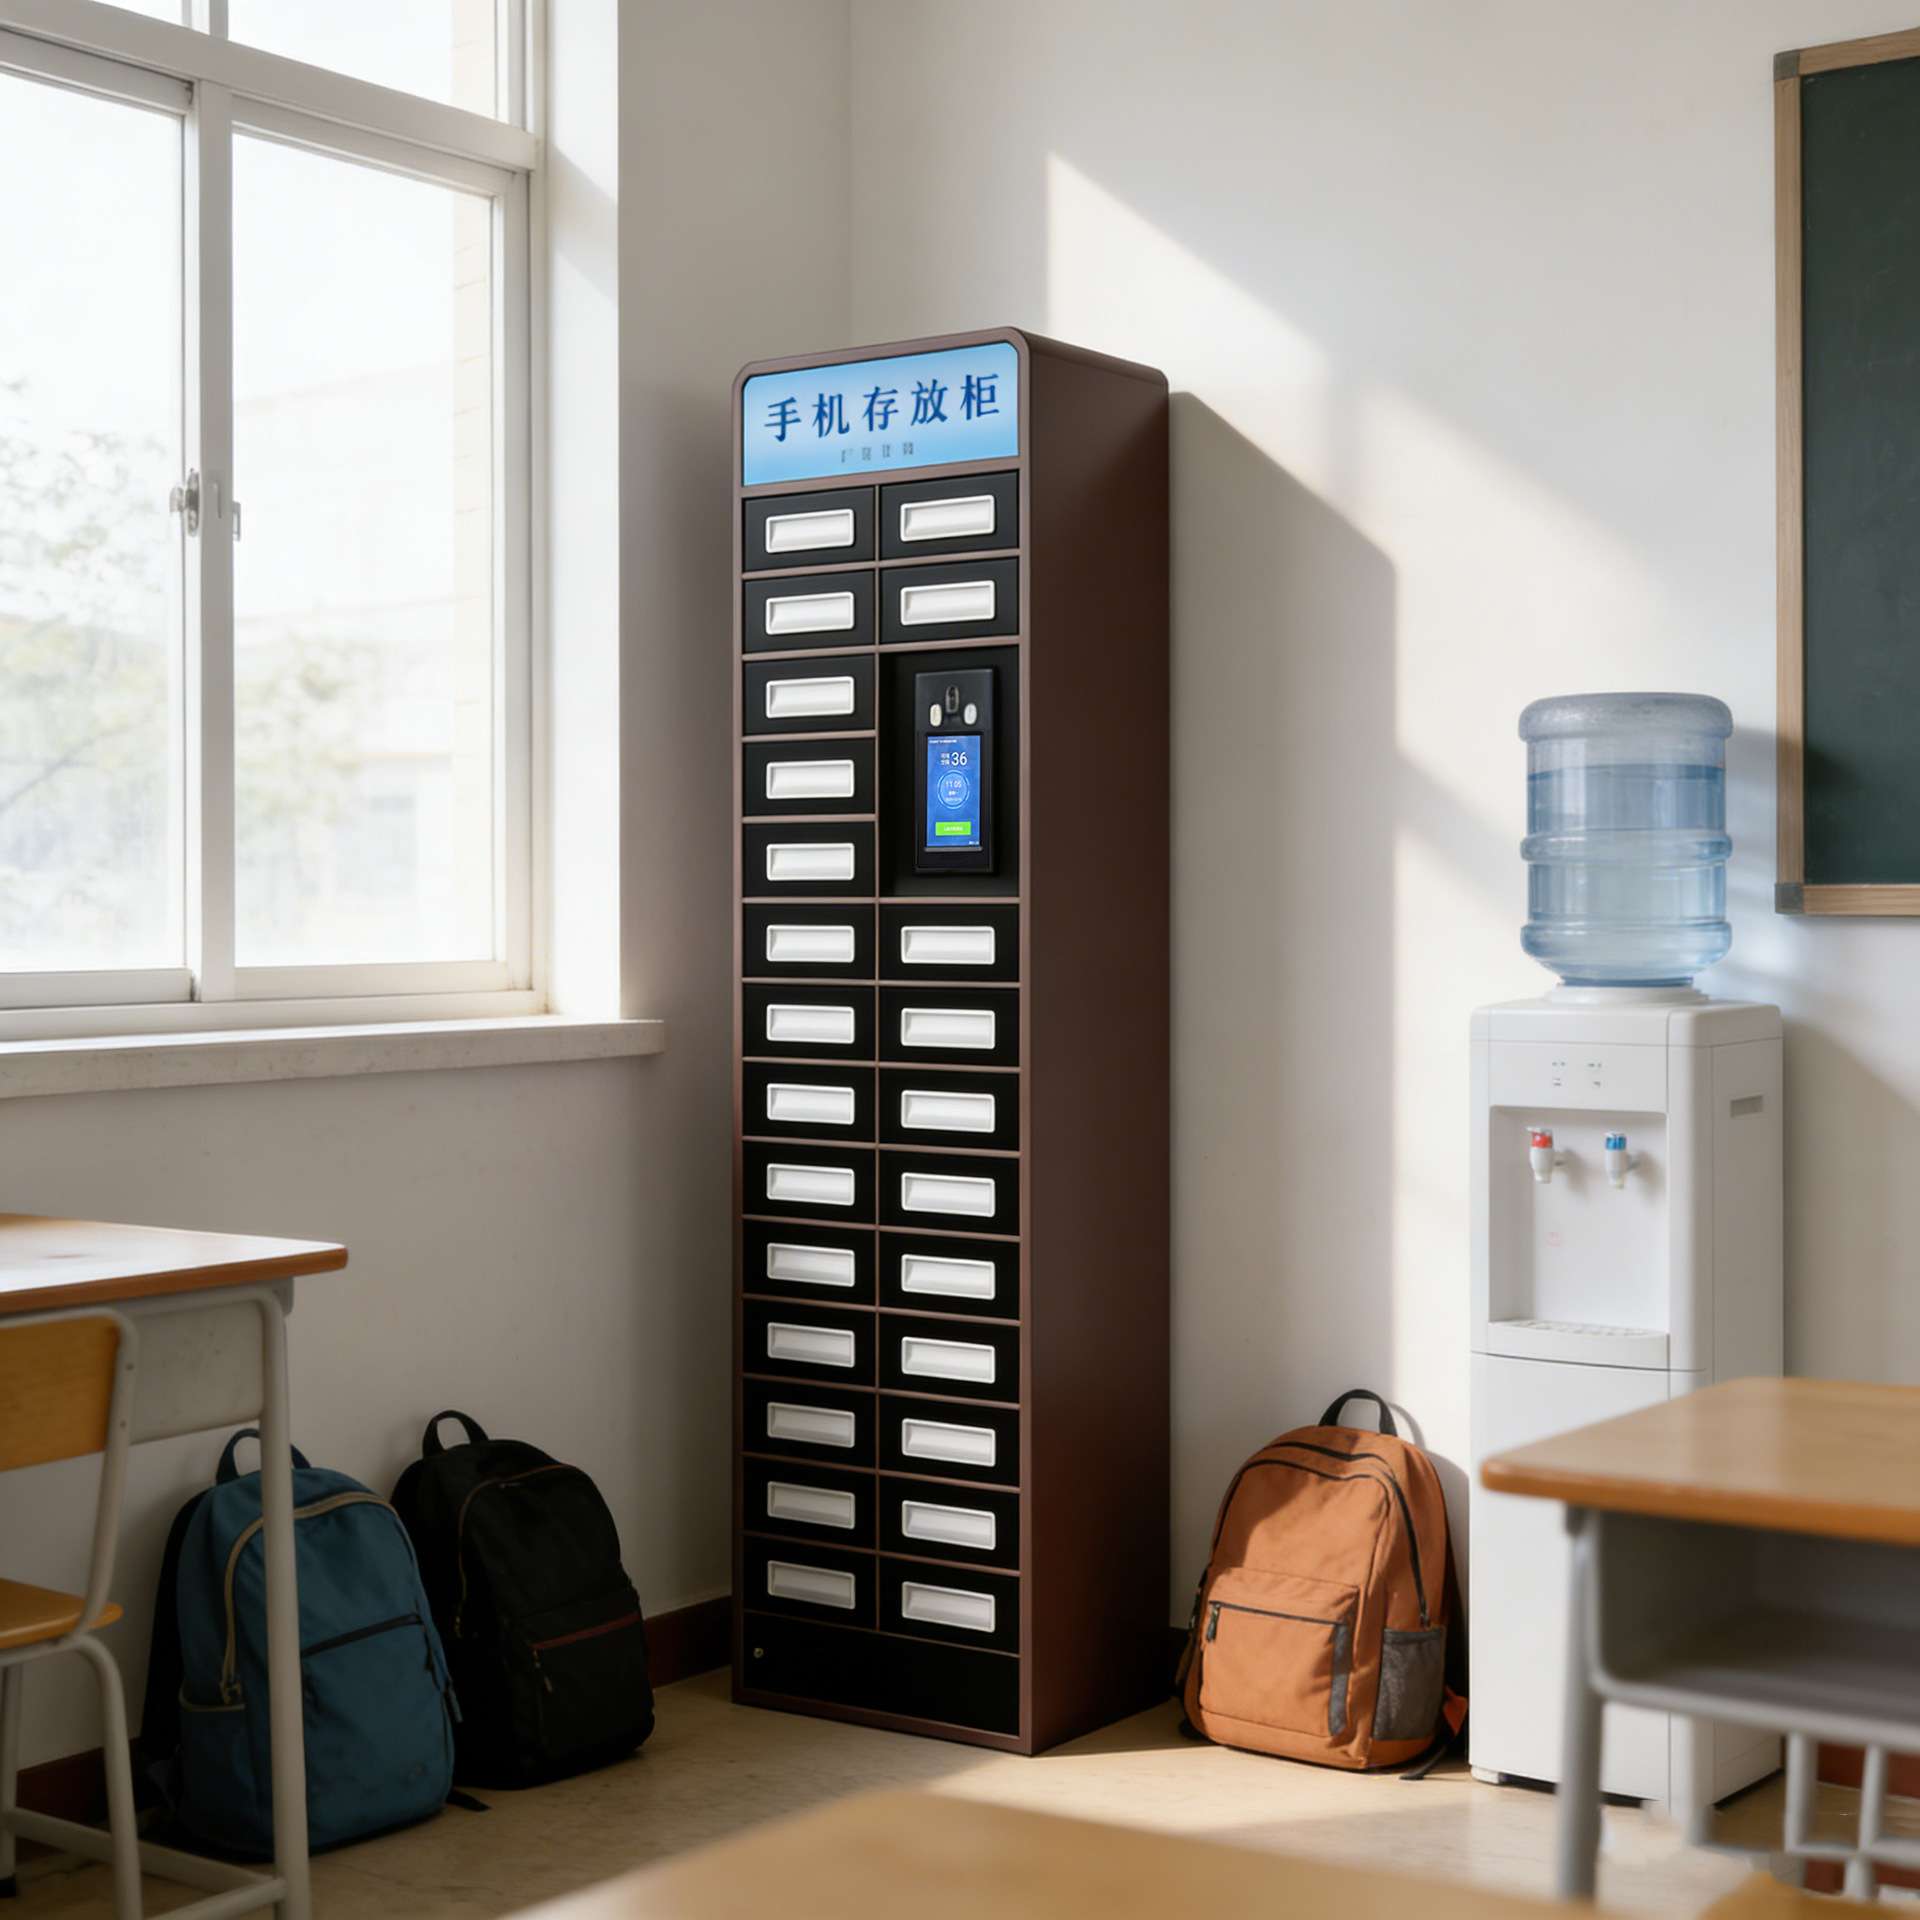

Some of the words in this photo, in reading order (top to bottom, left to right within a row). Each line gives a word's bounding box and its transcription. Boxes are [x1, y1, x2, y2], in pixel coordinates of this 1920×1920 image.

[764, 373, 1000, 443] 手机存放柜
[951, 751, 968, 766] 36
